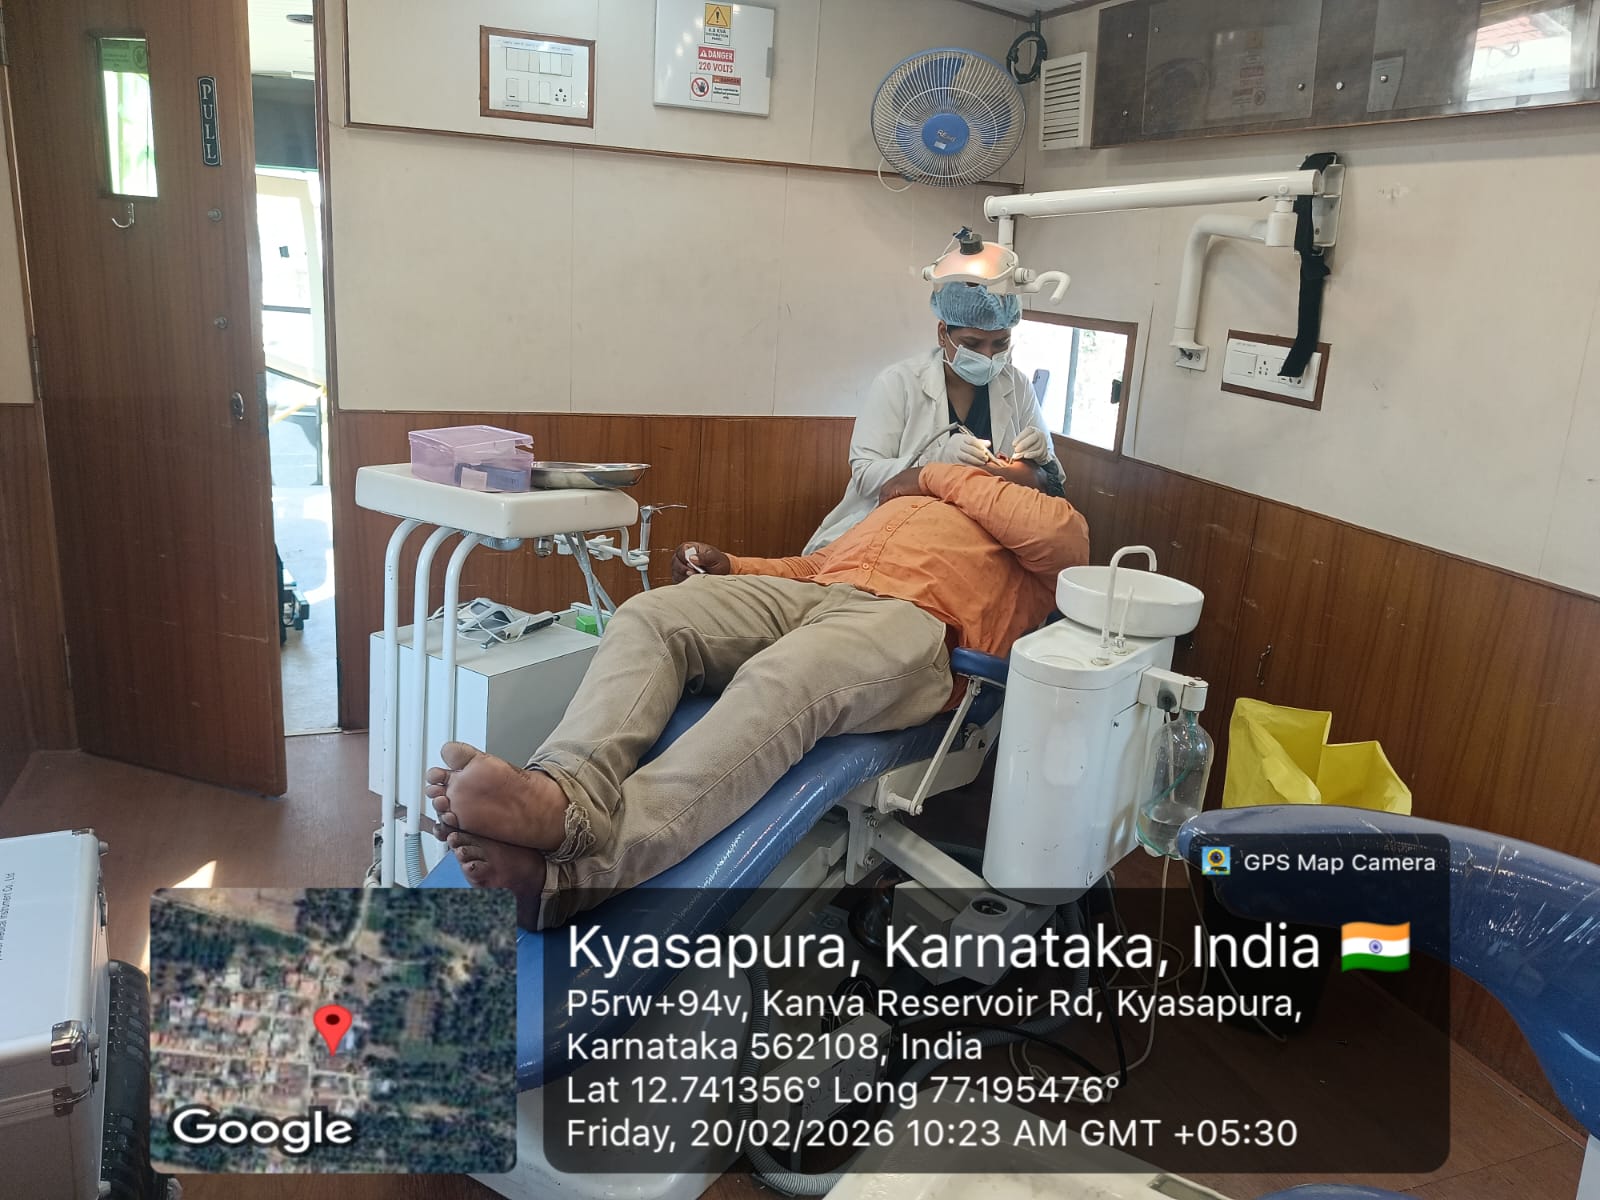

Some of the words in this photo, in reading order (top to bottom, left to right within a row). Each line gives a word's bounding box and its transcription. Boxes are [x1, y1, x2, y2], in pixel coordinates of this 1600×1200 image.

[708, 50, 733, 60] DANGER
[698, 61, 711, 71] 220
[713, 63, 733, 73] VOLTS
[202, 84, 216, 159] PULL
